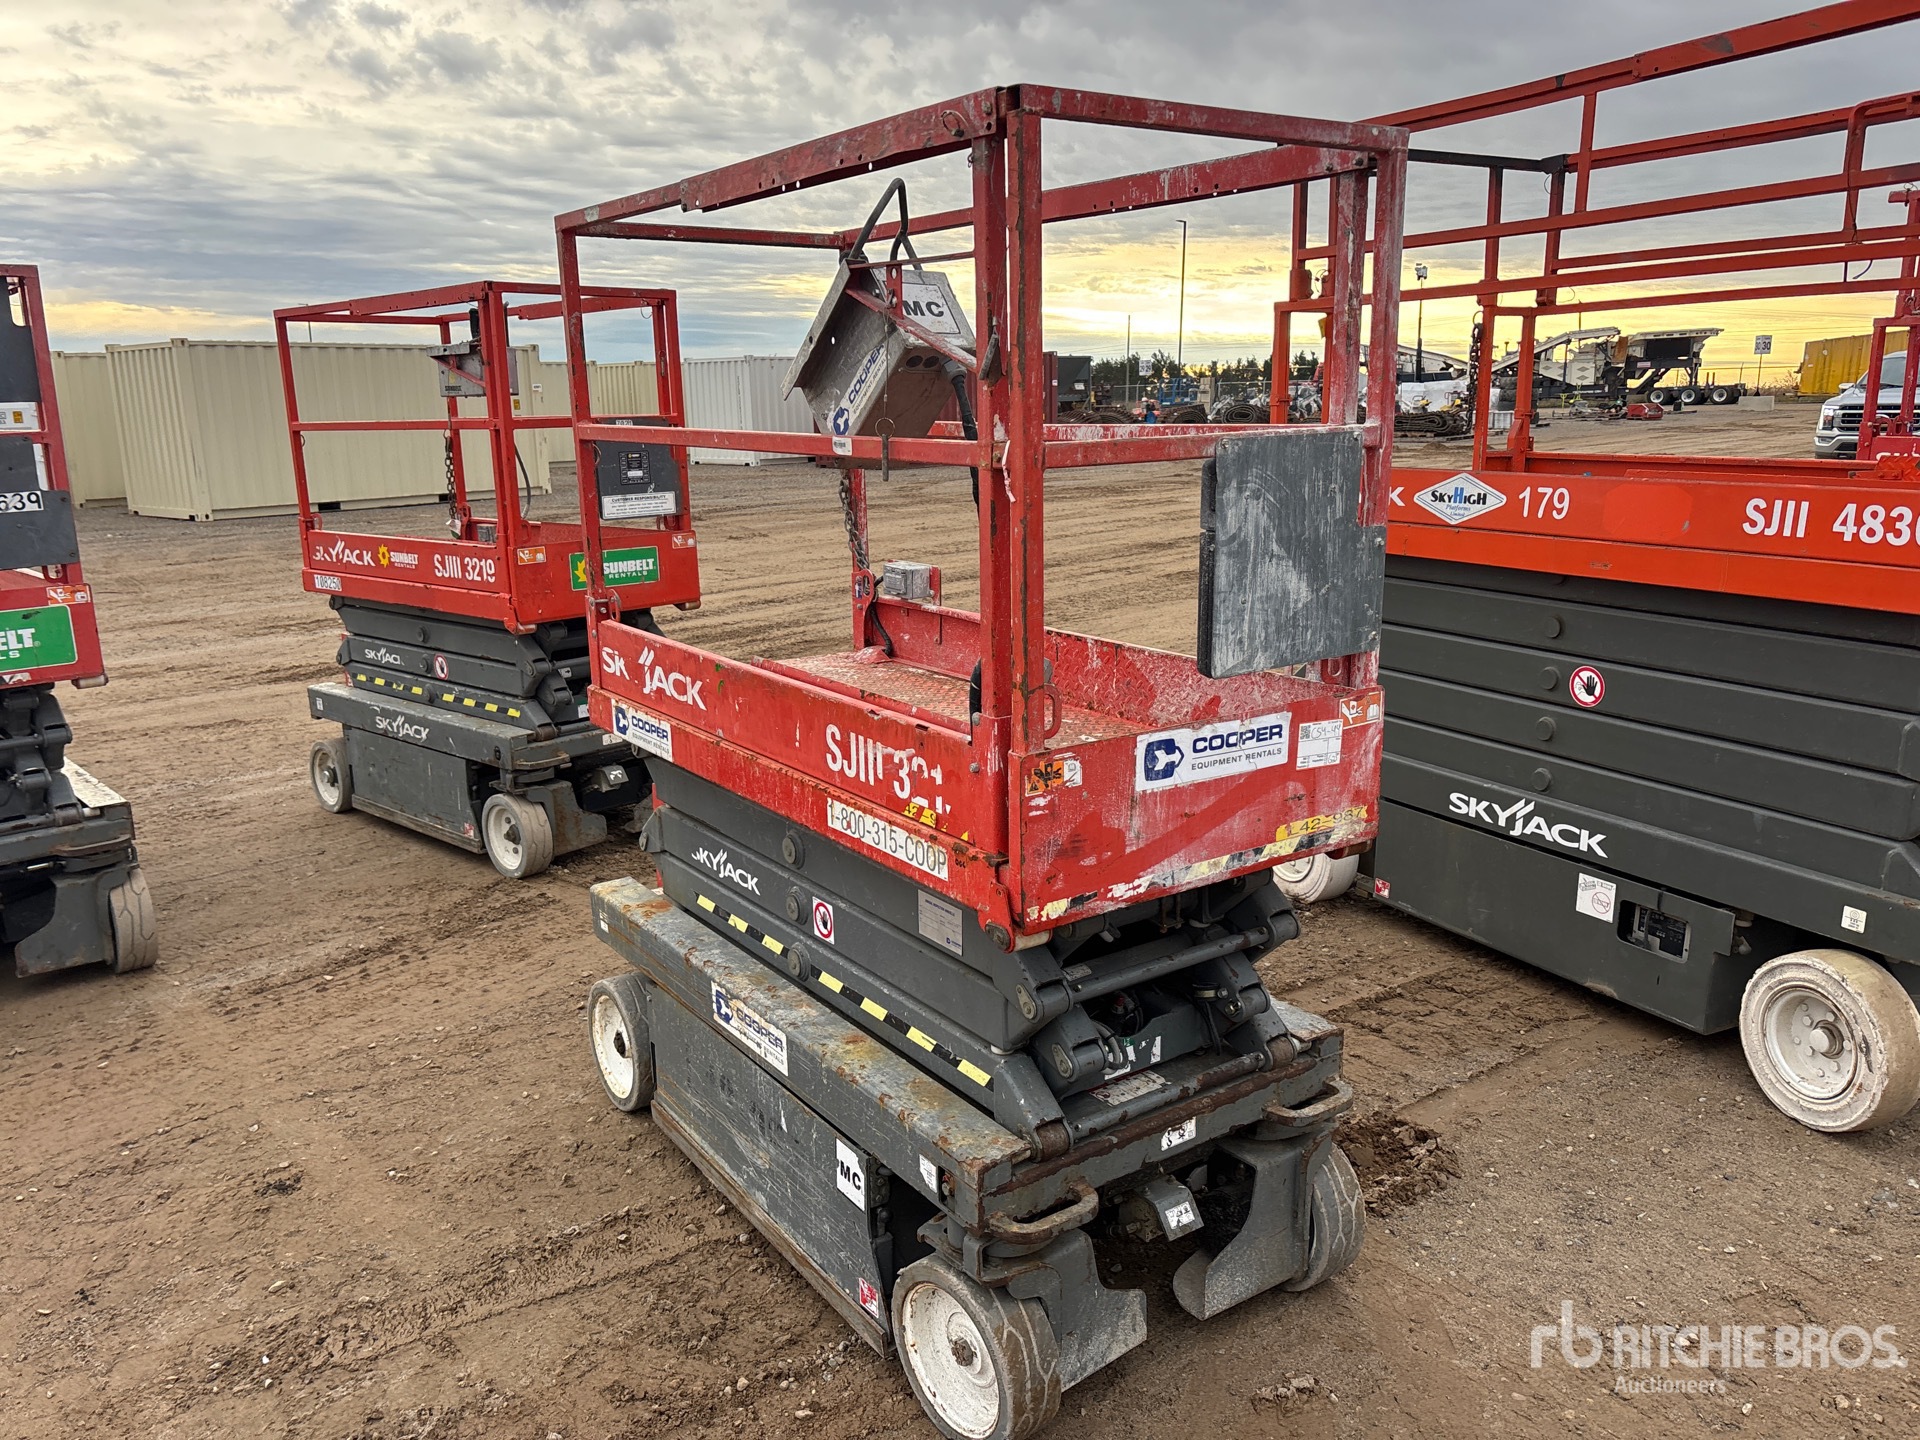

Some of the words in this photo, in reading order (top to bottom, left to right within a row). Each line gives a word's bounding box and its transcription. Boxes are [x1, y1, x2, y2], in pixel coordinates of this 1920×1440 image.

[904, 300, 944, 318] MC
[1430, 486, 1487, 506] SKYHIGH
[1518, 486, 1570, 520] 179
[1832, 503, 1920, 547] 483
[390, 552, 419, 565] SUNBELT
[603, 558, 655, 575] SUNBELT
[608, 570, 648, 579] RENTALS
[631, 715, 669, 742] COOPER
[1192, 723, 1283, 754] COOPER
[1191, 754, 1243, 771] EQUIPMENT
[1245, 747, 1283, 761] RENTALS
[1448, 791, 1608, 859] SKYJACK
[828, 803, 947, 875] 1-800-315-COOP
[840, 1160, 862, 1191] MC
